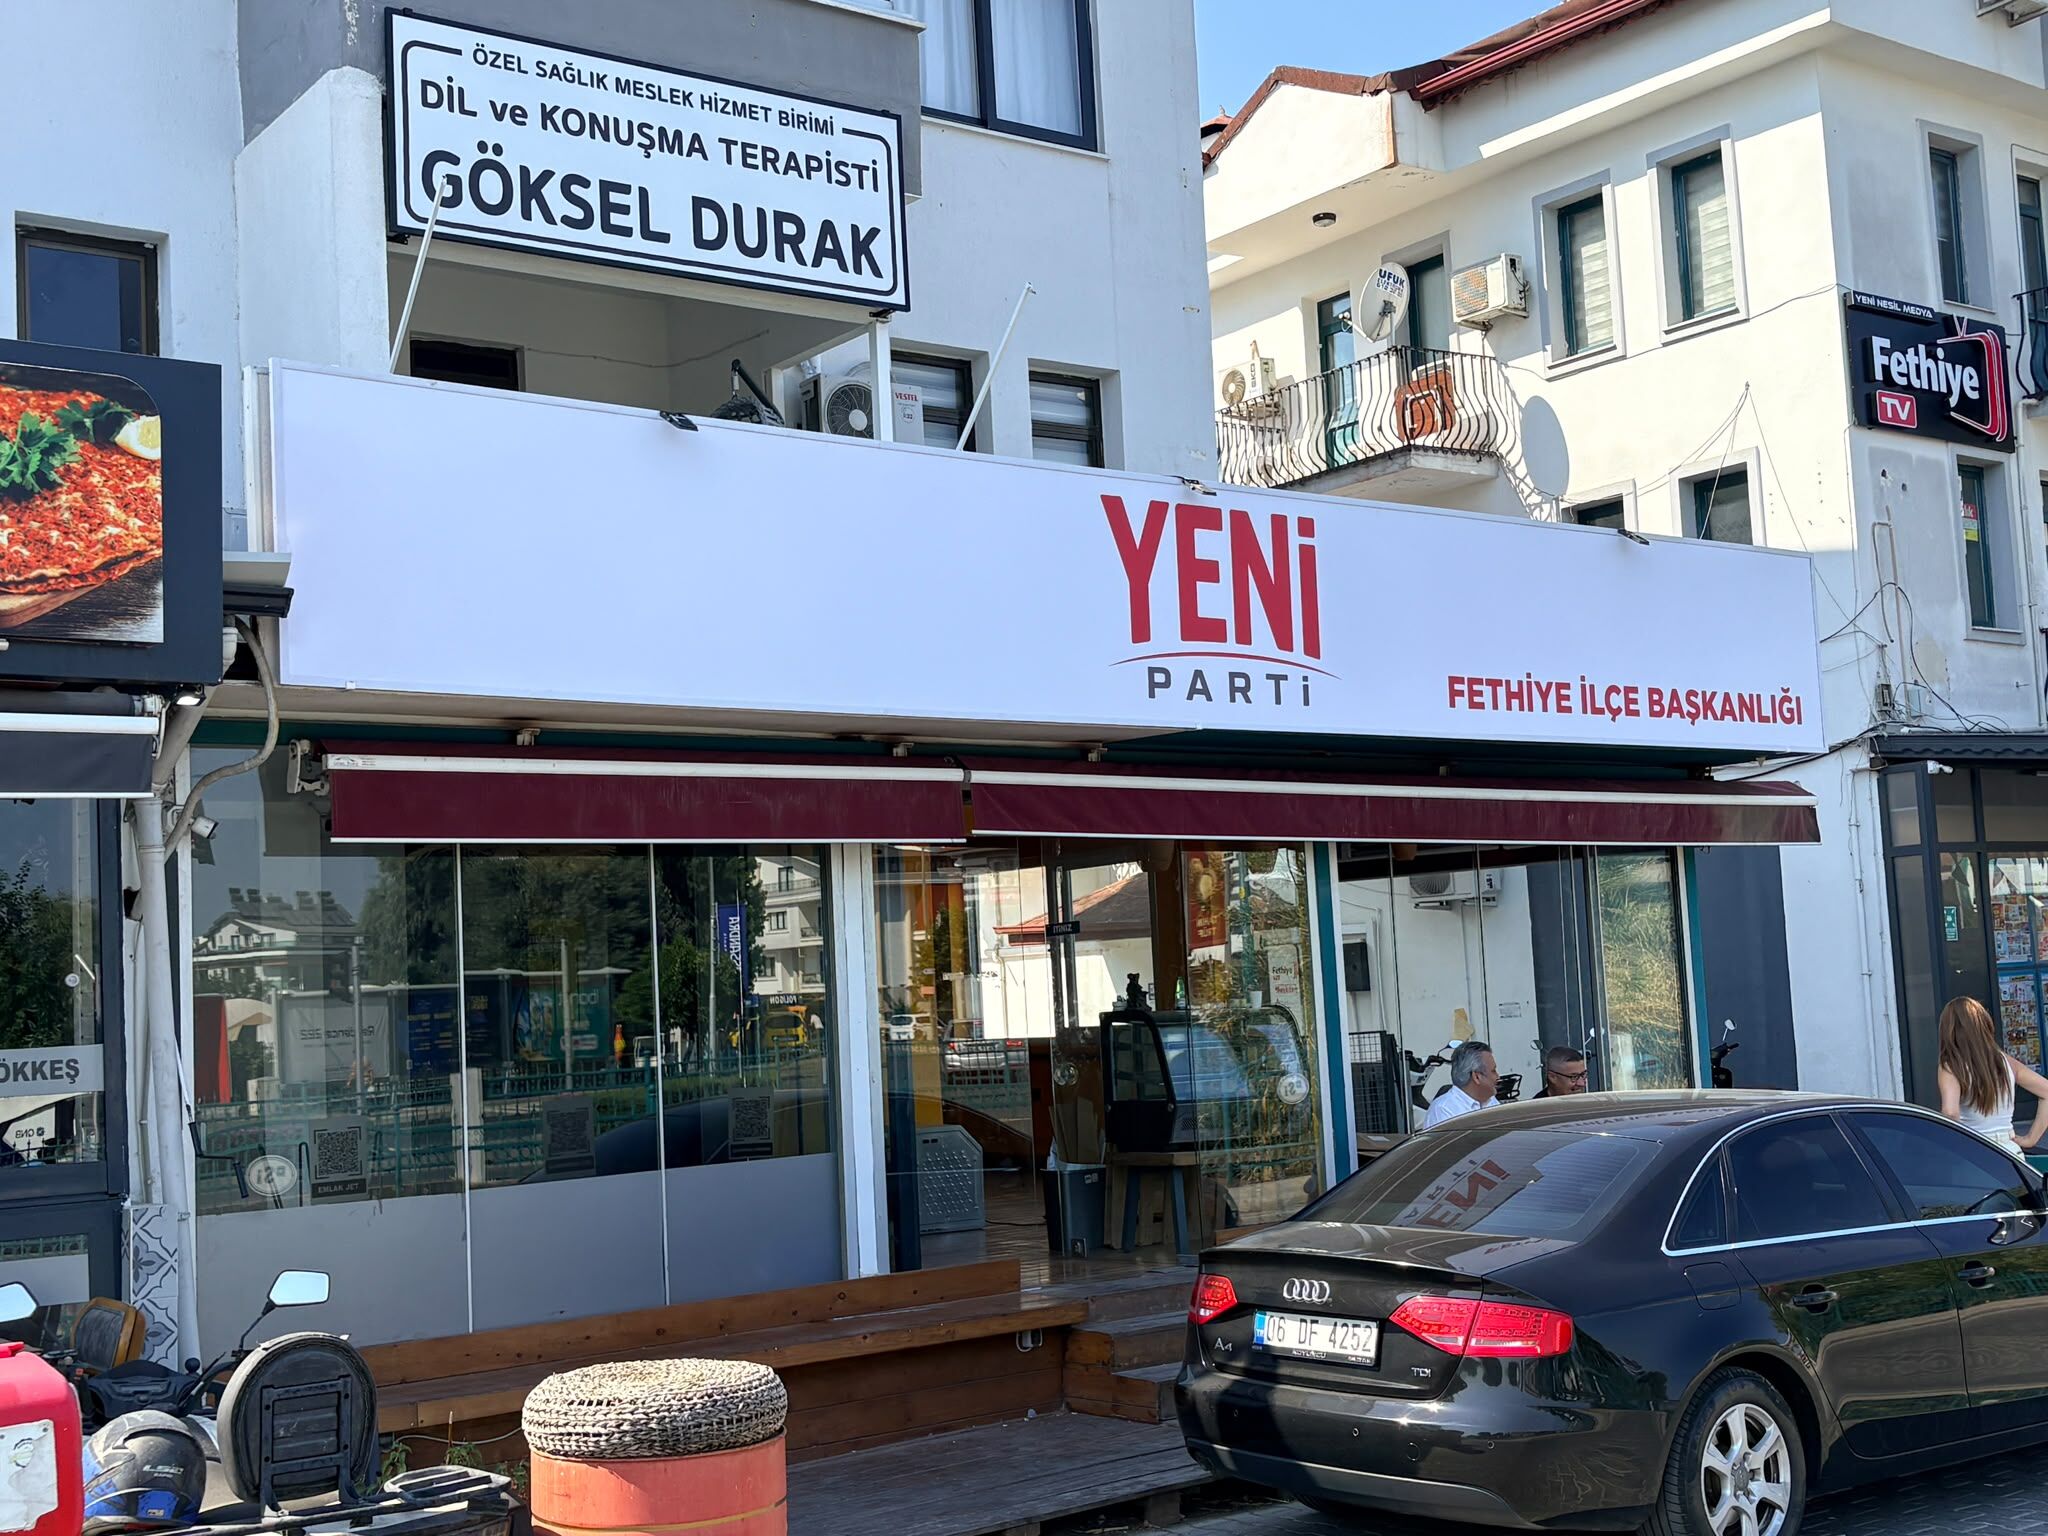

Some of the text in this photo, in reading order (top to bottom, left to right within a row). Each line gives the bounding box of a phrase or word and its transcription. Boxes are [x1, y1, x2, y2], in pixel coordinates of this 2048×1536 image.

[472, 43, 835, 136] ÖZEL SAĞLIK MESLEK HİZMET BİRİMİ
[421, 76, 879, 192] DİL ve KONUŞMA TERAPİSTİ
[422, 140, 883, 279] GÖKSEL DURAK
[1379, 269, 1405, 288] UFUK
[1855, 294, 1933, 318] YENİ NESİL MEDYA
[1872, 335, 1980, 408] Fethiye
[895, 392, 919, 401] VESTEL
[1881, 397, 1911, 420] TV
[1448, 672, 1803, 726] FETHİYE İLÇE BAŞKANLIĞI
[1214, 1338, 1232, 1352] A4
[1267, 1315, 1373, 1353] 06 DF 4252
